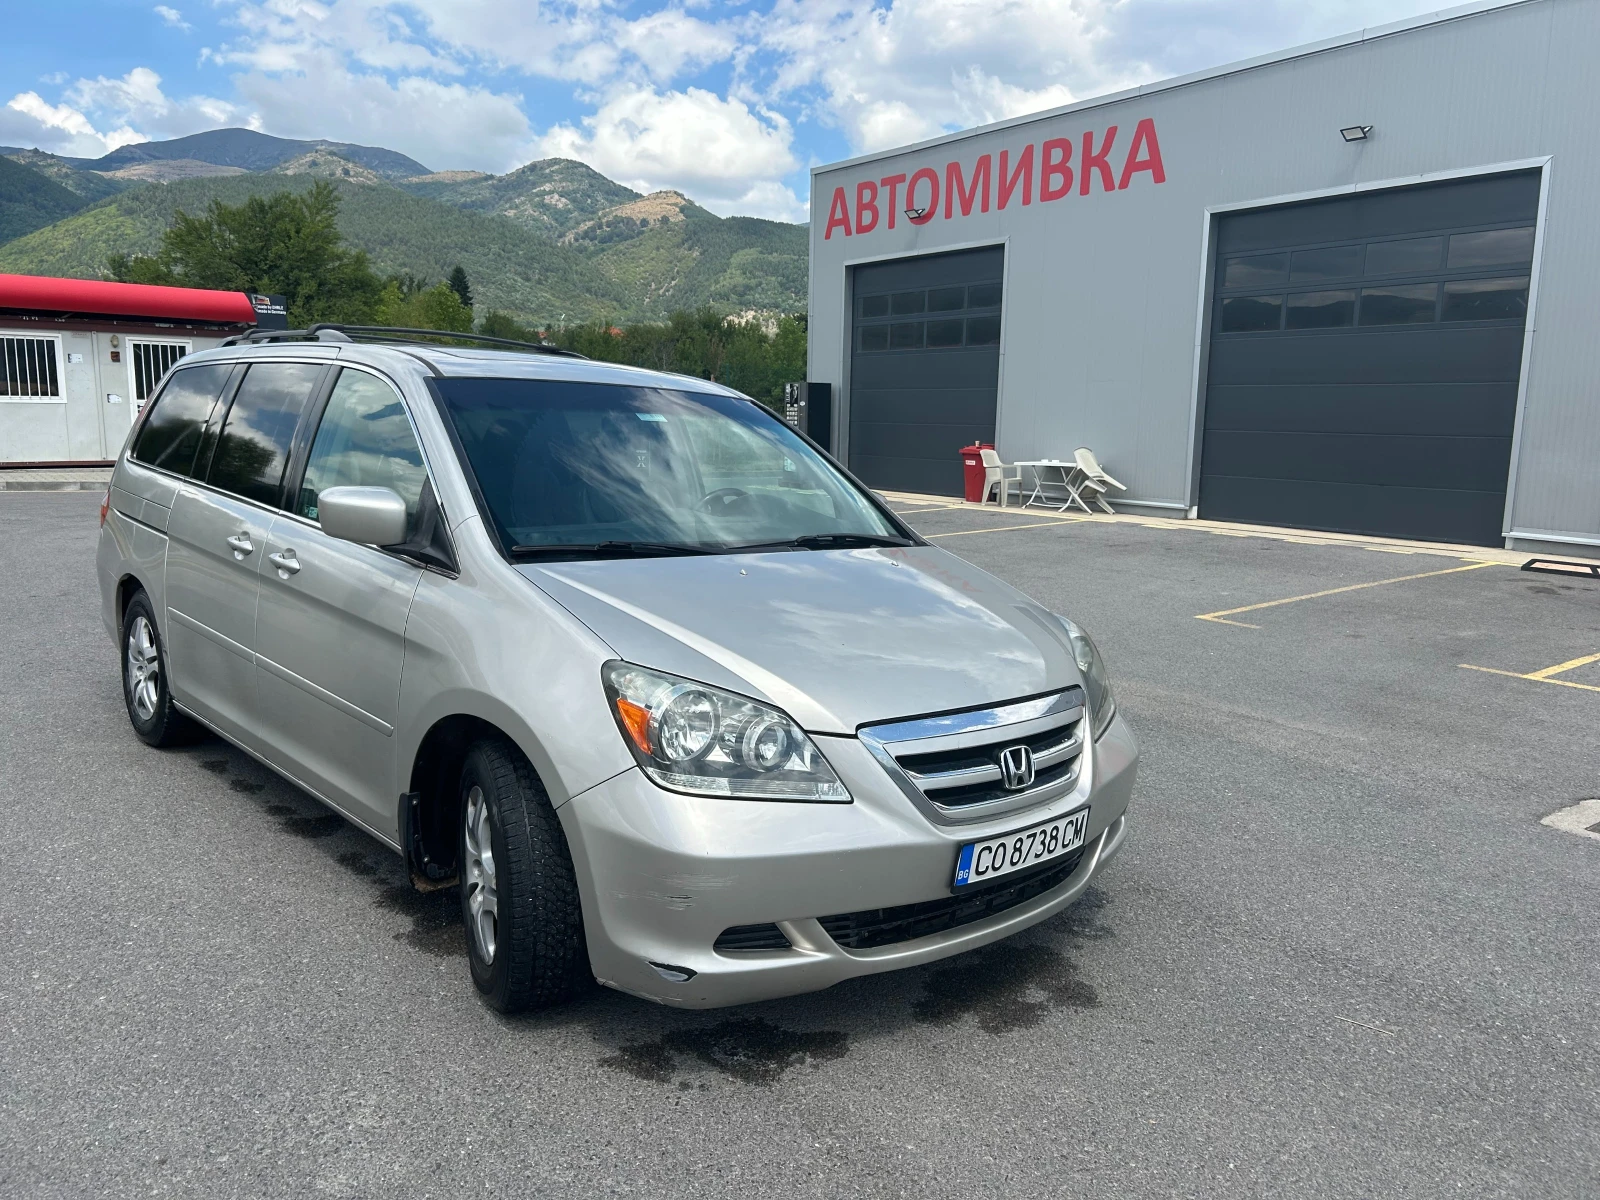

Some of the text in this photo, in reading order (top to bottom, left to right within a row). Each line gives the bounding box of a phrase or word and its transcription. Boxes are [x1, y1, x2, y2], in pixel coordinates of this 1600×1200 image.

[824, 118, 1166, 240] АВТОМИВКА
[1009, 825, 1060, 867] 8738
[957, 869, 969, 880] BG
